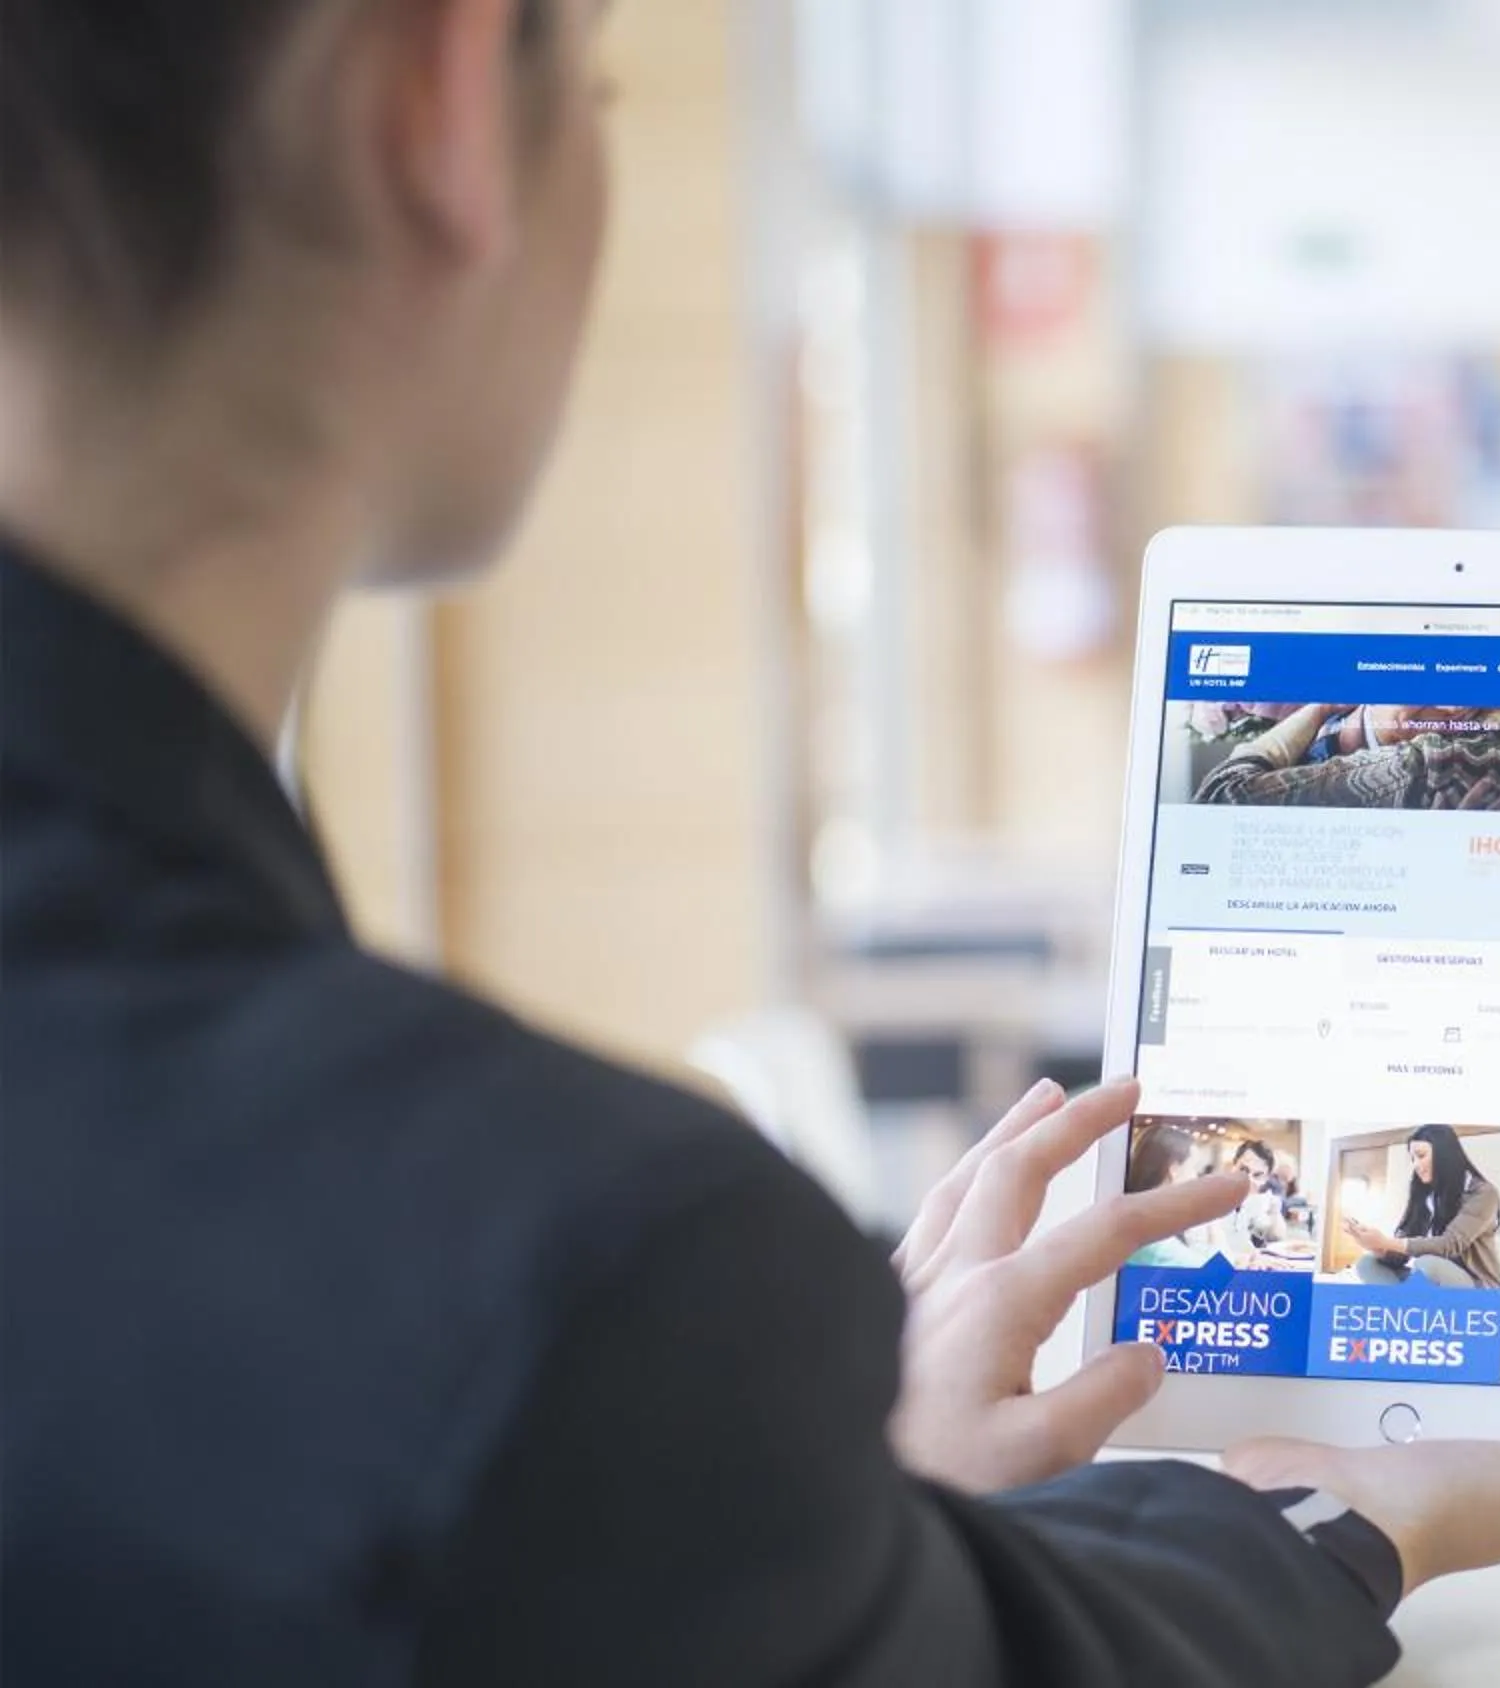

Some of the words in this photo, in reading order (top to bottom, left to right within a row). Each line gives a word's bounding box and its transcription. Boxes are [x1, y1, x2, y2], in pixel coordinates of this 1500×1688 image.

[1402, 719, 1447, 730] ahorran
[1449, 719, 1480, 731] hasta
[1287, 901, 1300, 911] LA
[1362, 903, 1397, 913] AHORA
[1268, 947, 1298, 958] HOTEL
[1377, 954, 1432, 966] GESTIONAR
[1140, 1287, 1291, 1318] DESAYUNO
[1333, 1304, 1499, 1337] ESENCIALES
[1137, 1318, 1271, 1349] EXPRESS
[1329, 1336, 1465, 1367] EXPRESS
